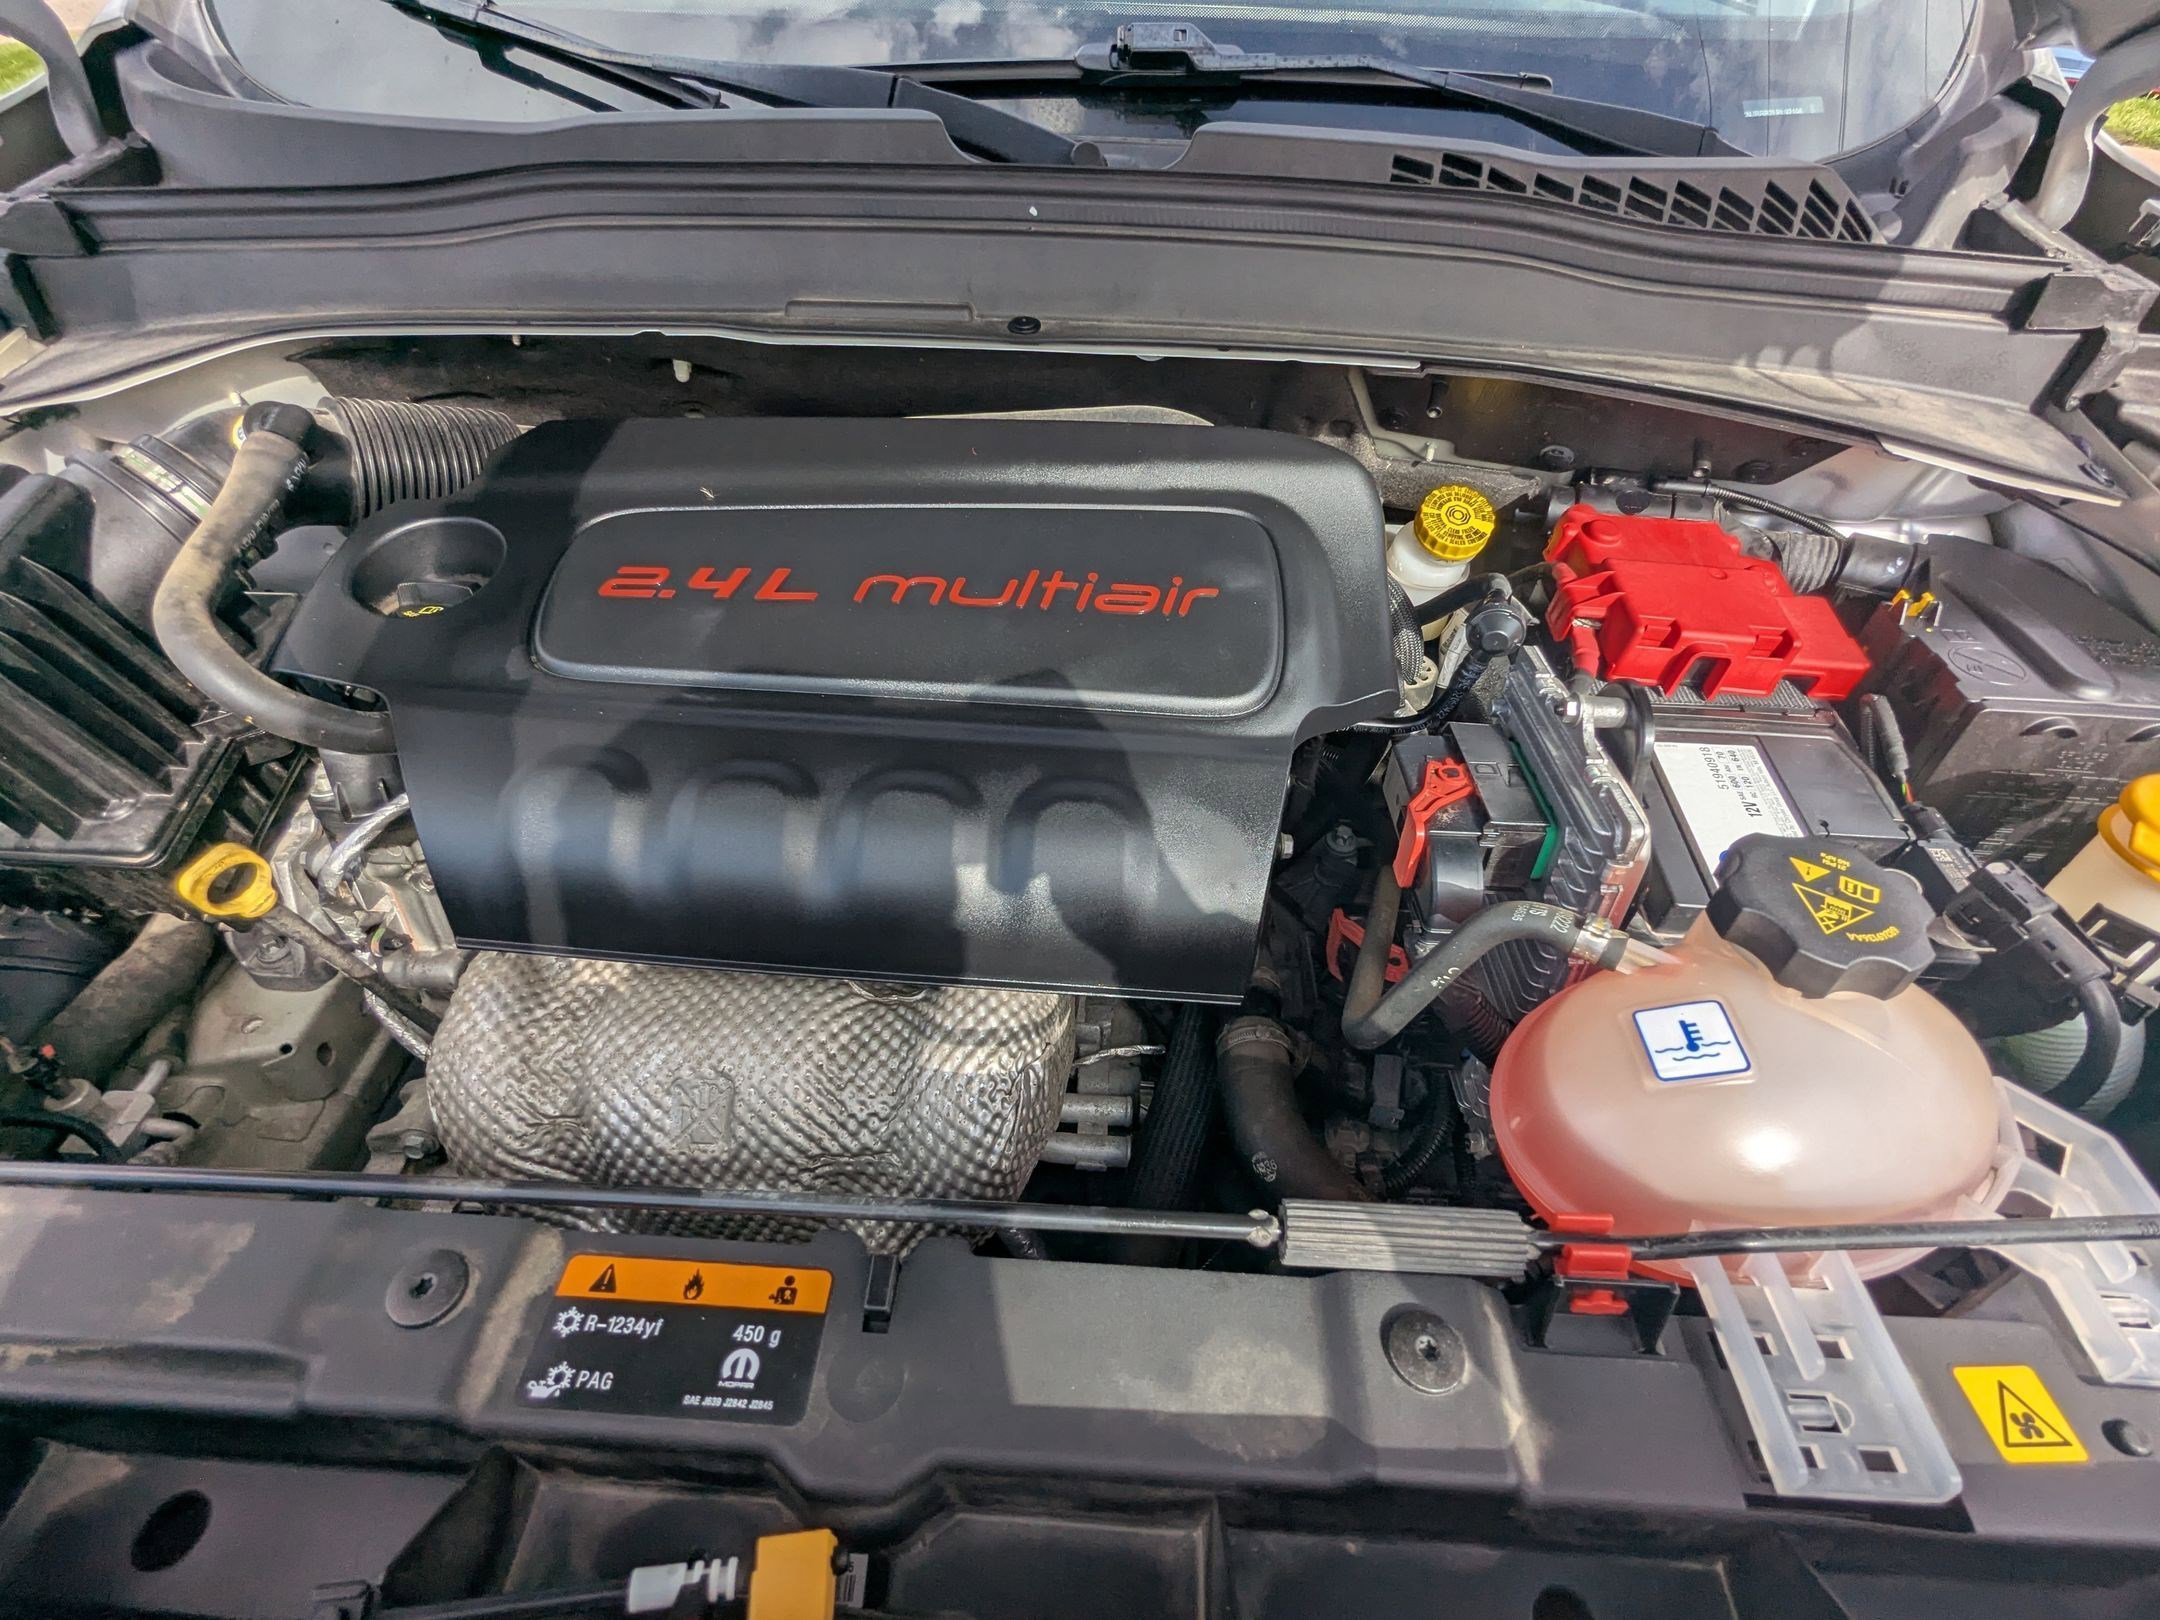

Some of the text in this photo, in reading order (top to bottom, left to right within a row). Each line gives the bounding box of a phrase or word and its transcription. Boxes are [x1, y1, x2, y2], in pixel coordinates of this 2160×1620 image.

[853, 569, 1220, 617] multiair
[1727, 749, 1740, 762] 640
[1699, 746, 1730, 790] 51940918
[1741, 776, 1754, 788] 120
[1741, 801, 1763, 817] 12V
[583, 1313, 665, 1340] R-1234yf
[732, 1324, 783, 1348] 450 g
[575, 1370, 615, 1391] PAG
[682, 1394, 701, 1406] SAE
